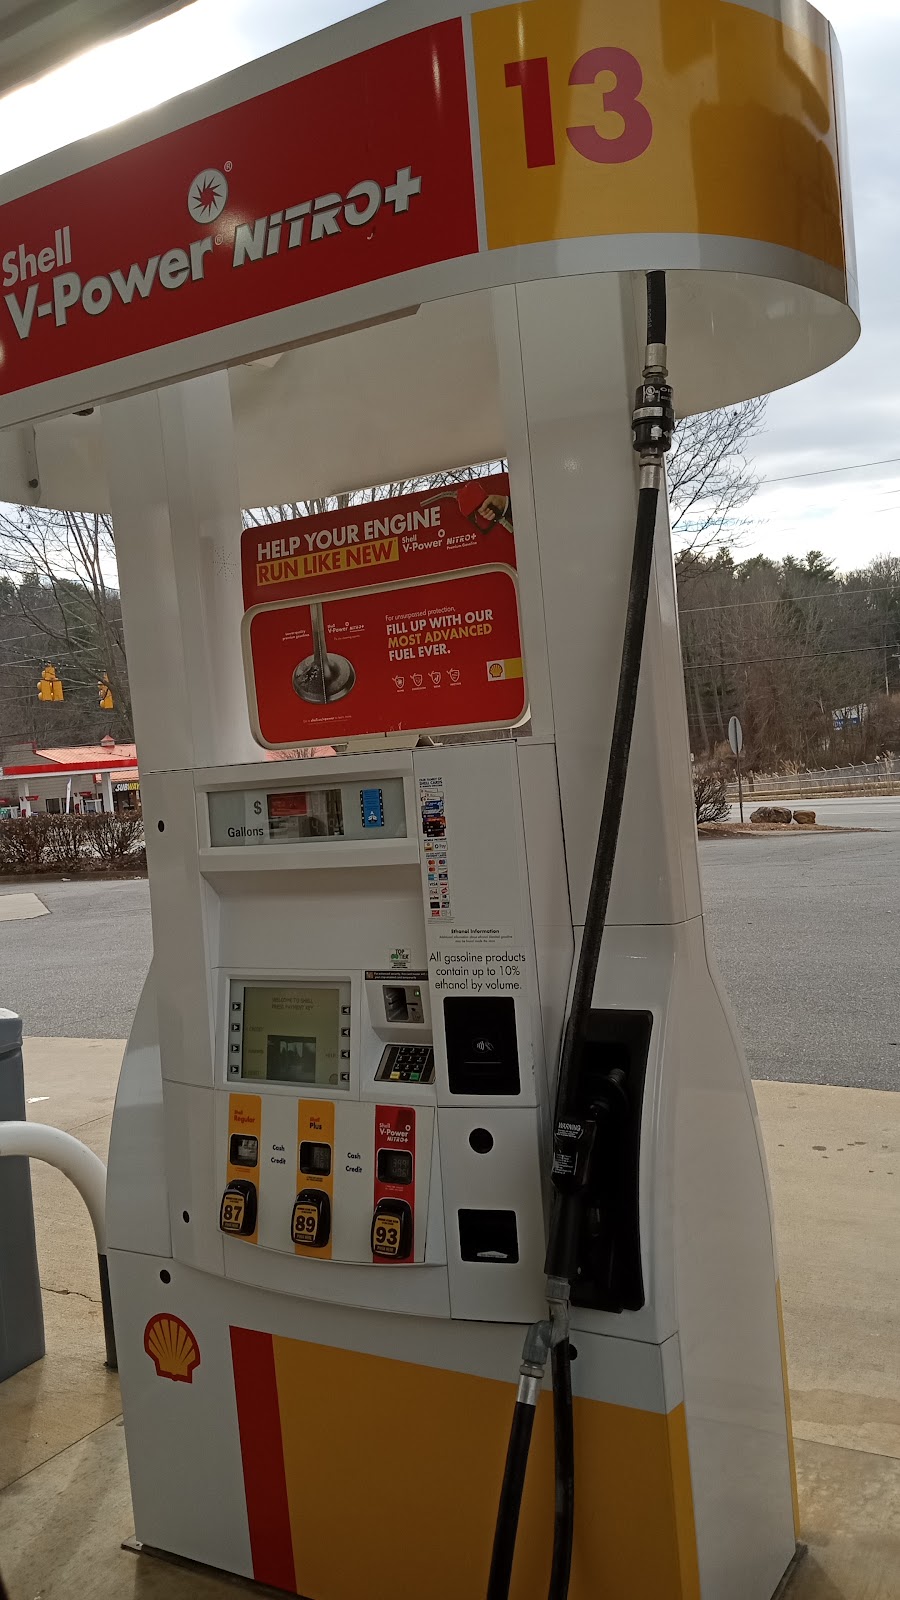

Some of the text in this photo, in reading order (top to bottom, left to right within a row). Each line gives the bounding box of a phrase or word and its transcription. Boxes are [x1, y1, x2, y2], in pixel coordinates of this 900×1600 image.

[504, 46, 653, 169] 13
[2, 226, 72, 287] Shell
[258, 506, 441, 561] HELP YOUR ENGINE
[402, 534, 417, 544] Shell
[402, 539, 443, 553] V-Power
[258, 560, 299, 583] RUN
[303, 551, 341, 575] LIKE
[394, 609, 426, 620] unsurpassed
[428, 606, 456, 617] protection,
[386, 608, 494, 636] FILL UP WITH OUR
[388, 623, 493, 648] MOST ADVANCED
[389, 644, 451, 661] FUEL EVER.
[115, 782, 140, 792] SUBWAY
[253, 800, 263, 816] $
[227, 827, 264, 838] Gallons
[430, 950, 526, 965] All gasoline products
[436, 966, 469, 976] contain
[472, 969, 484, 978] up
[487, 966, 496, 976] to
[500, 965, 520, 976] 10%
[434, 978, 522, 992] ethanol by volume.
[234, 1114, 256, 1124] Regular
[310, 1122, 322, 1130] Plus
[380, 1128, 409, 1138] V-Power
[558, 1122, 582, 1132] WARNING
[272, 1144, 285, 1152] Cash
[270, 1156, 286, 1165] Credit
[347, 1152, 361, 1160] Cash
[224, 1204, 242, 1222] 87
[296, 1214, 316, 1233] 89
[376, 1226, 398, 1246] 93
